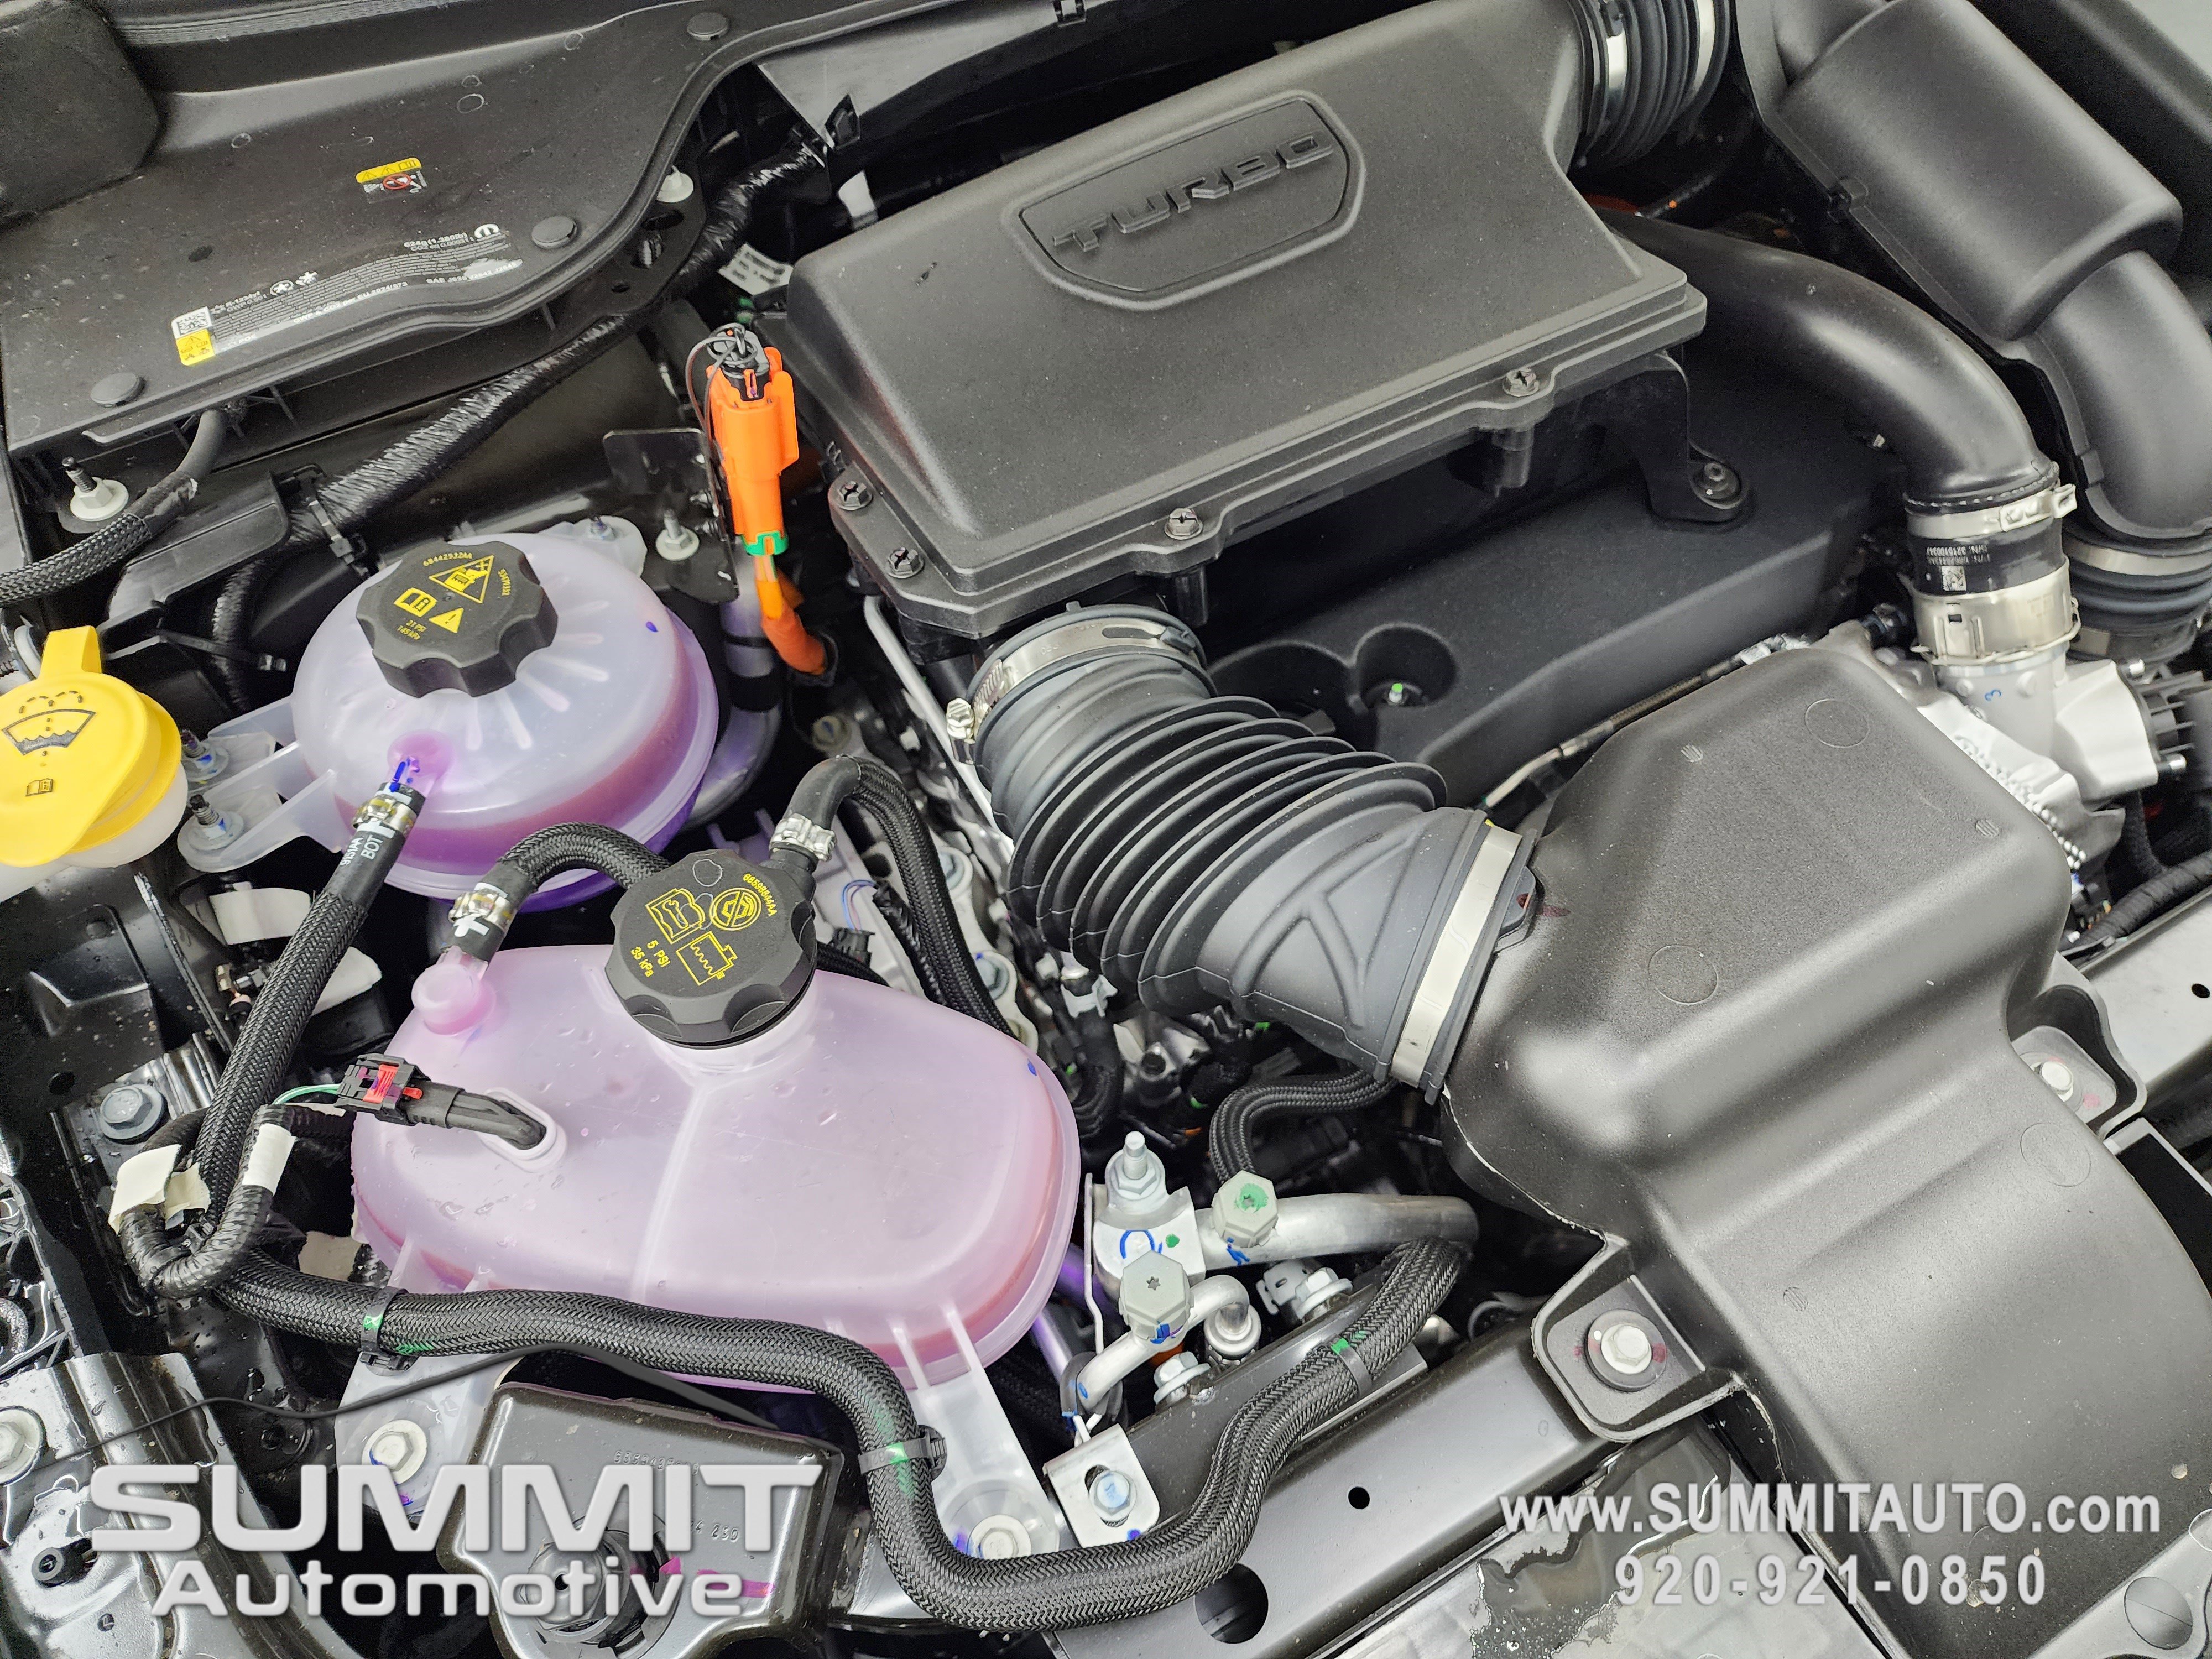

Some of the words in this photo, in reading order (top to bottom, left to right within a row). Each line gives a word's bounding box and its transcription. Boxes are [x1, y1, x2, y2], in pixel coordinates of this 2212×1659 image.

[1052, 128, 1333, 252] TURBO
[361, 834, 384, 860] BOT
[630, 946, 645, 960] 35
[654, 949, 671, 968] PSI
